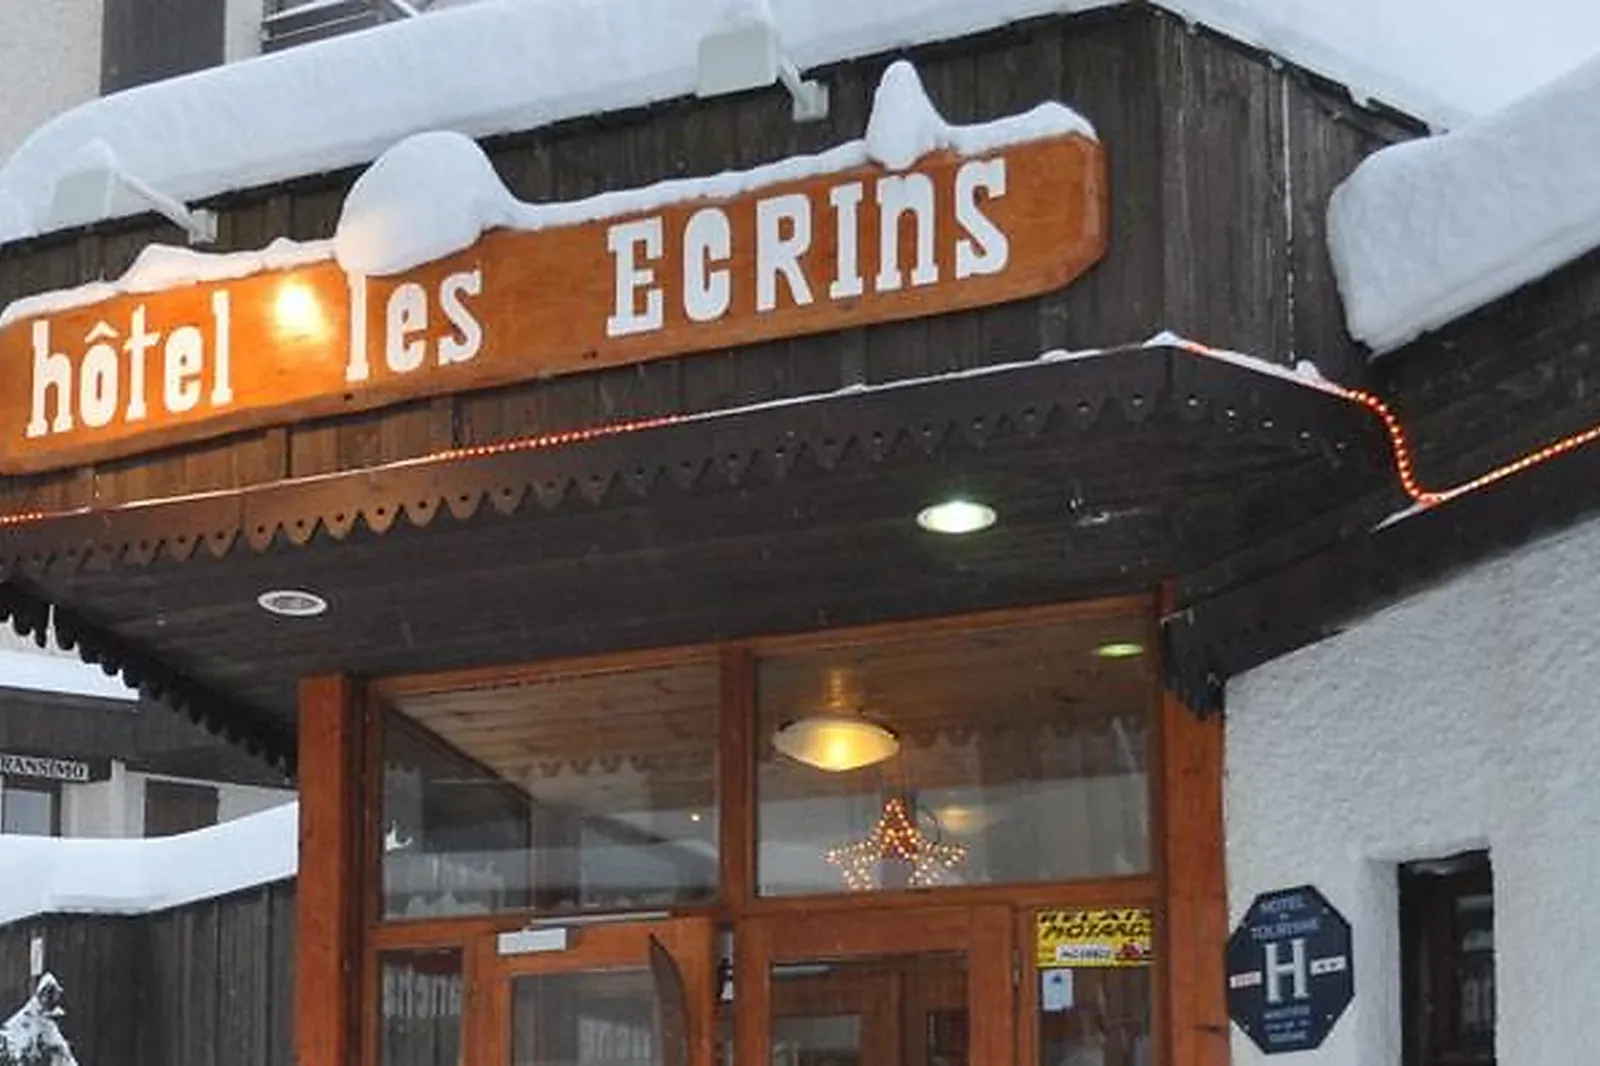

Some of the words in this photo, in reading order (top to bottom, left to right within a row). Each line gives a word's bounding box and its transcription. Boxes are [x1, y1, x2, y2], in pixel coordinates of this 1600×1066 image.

[26, 289, 234, 438] hôtel
[345, 268, 484, 382] les
[1264, 937, 1310, 1004] H
